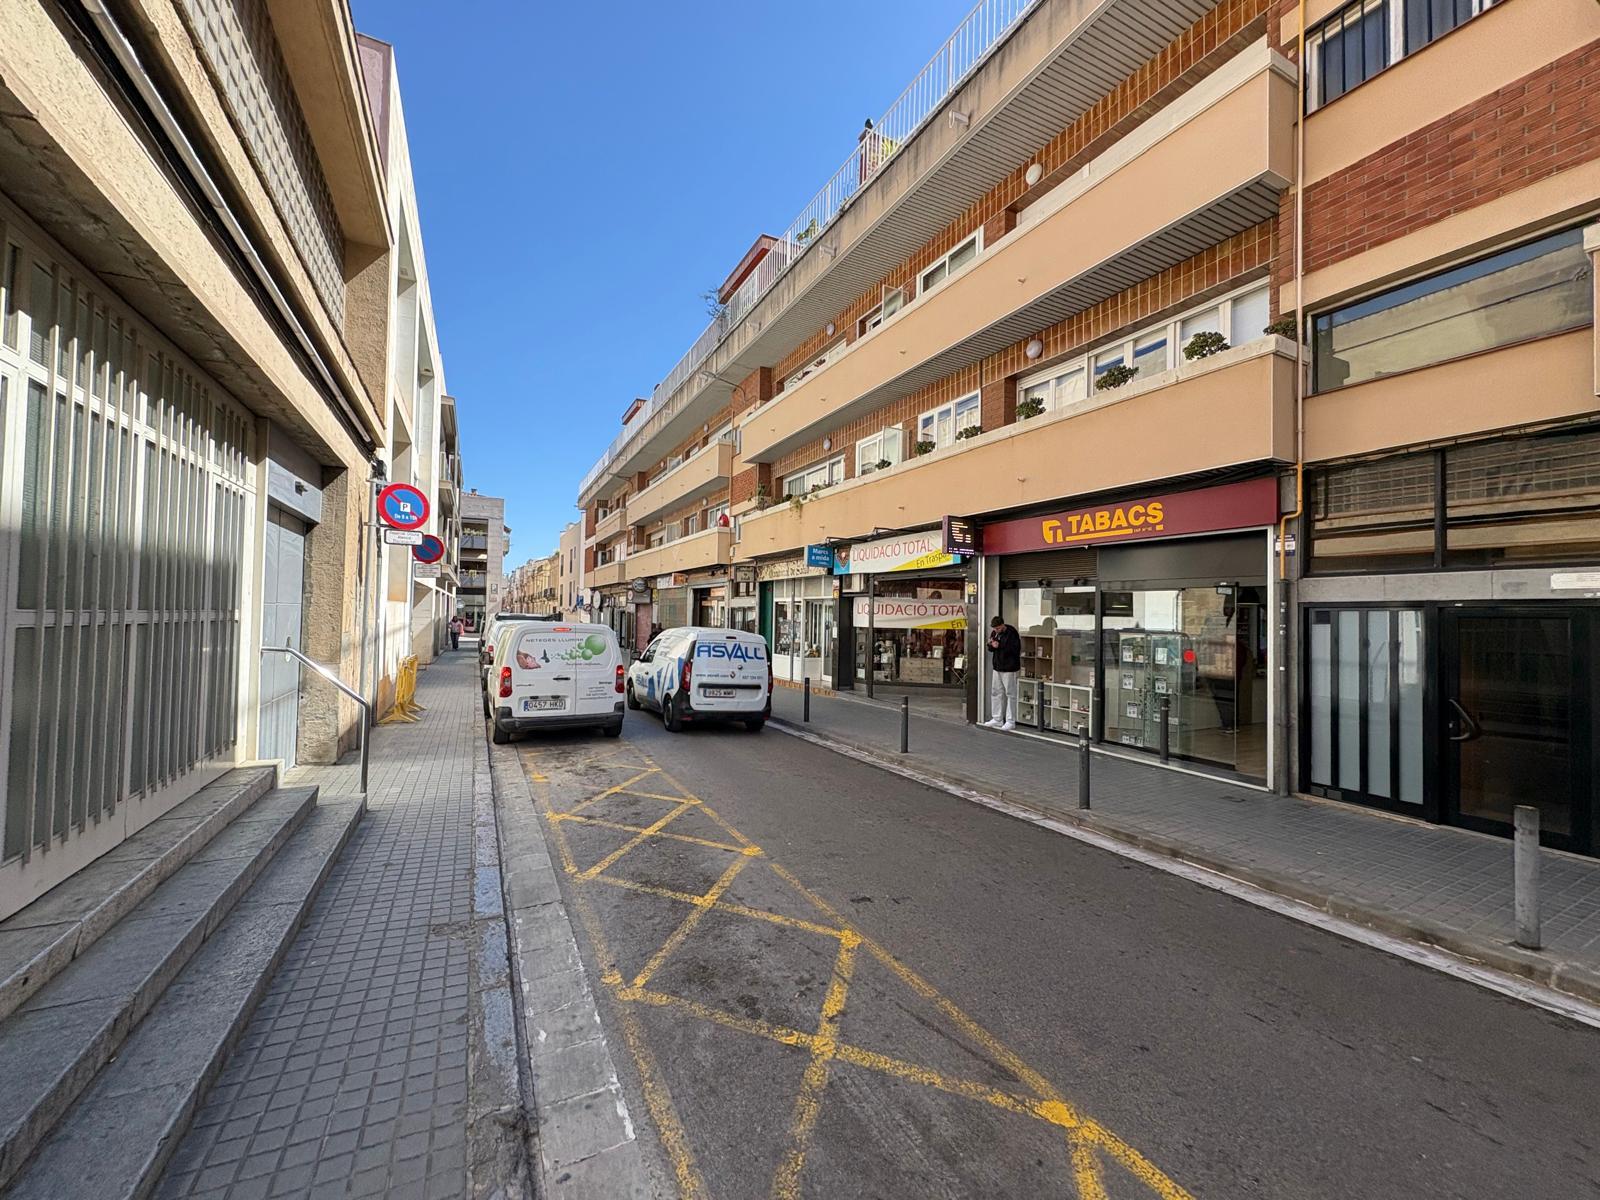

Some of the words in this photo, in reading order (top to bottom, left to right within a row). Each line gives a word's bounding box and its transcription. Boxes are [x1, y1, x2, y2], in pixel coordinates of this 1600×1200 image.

[402, 503, 408, 511] P
[1067, 502, 1164, 534] TABACS
[852, 540, 901, 562] LIQUIDACIÓ
[903, 538, 933, 555] TOTAL
[916, 559, 925, 568] En
[857, 603, 928, 616] LIQUIDACIÓ
[951, 620, 963, 629] En
[696, 643, 765, 663] ASVALL
[528, 701, 547, 709] 0457
